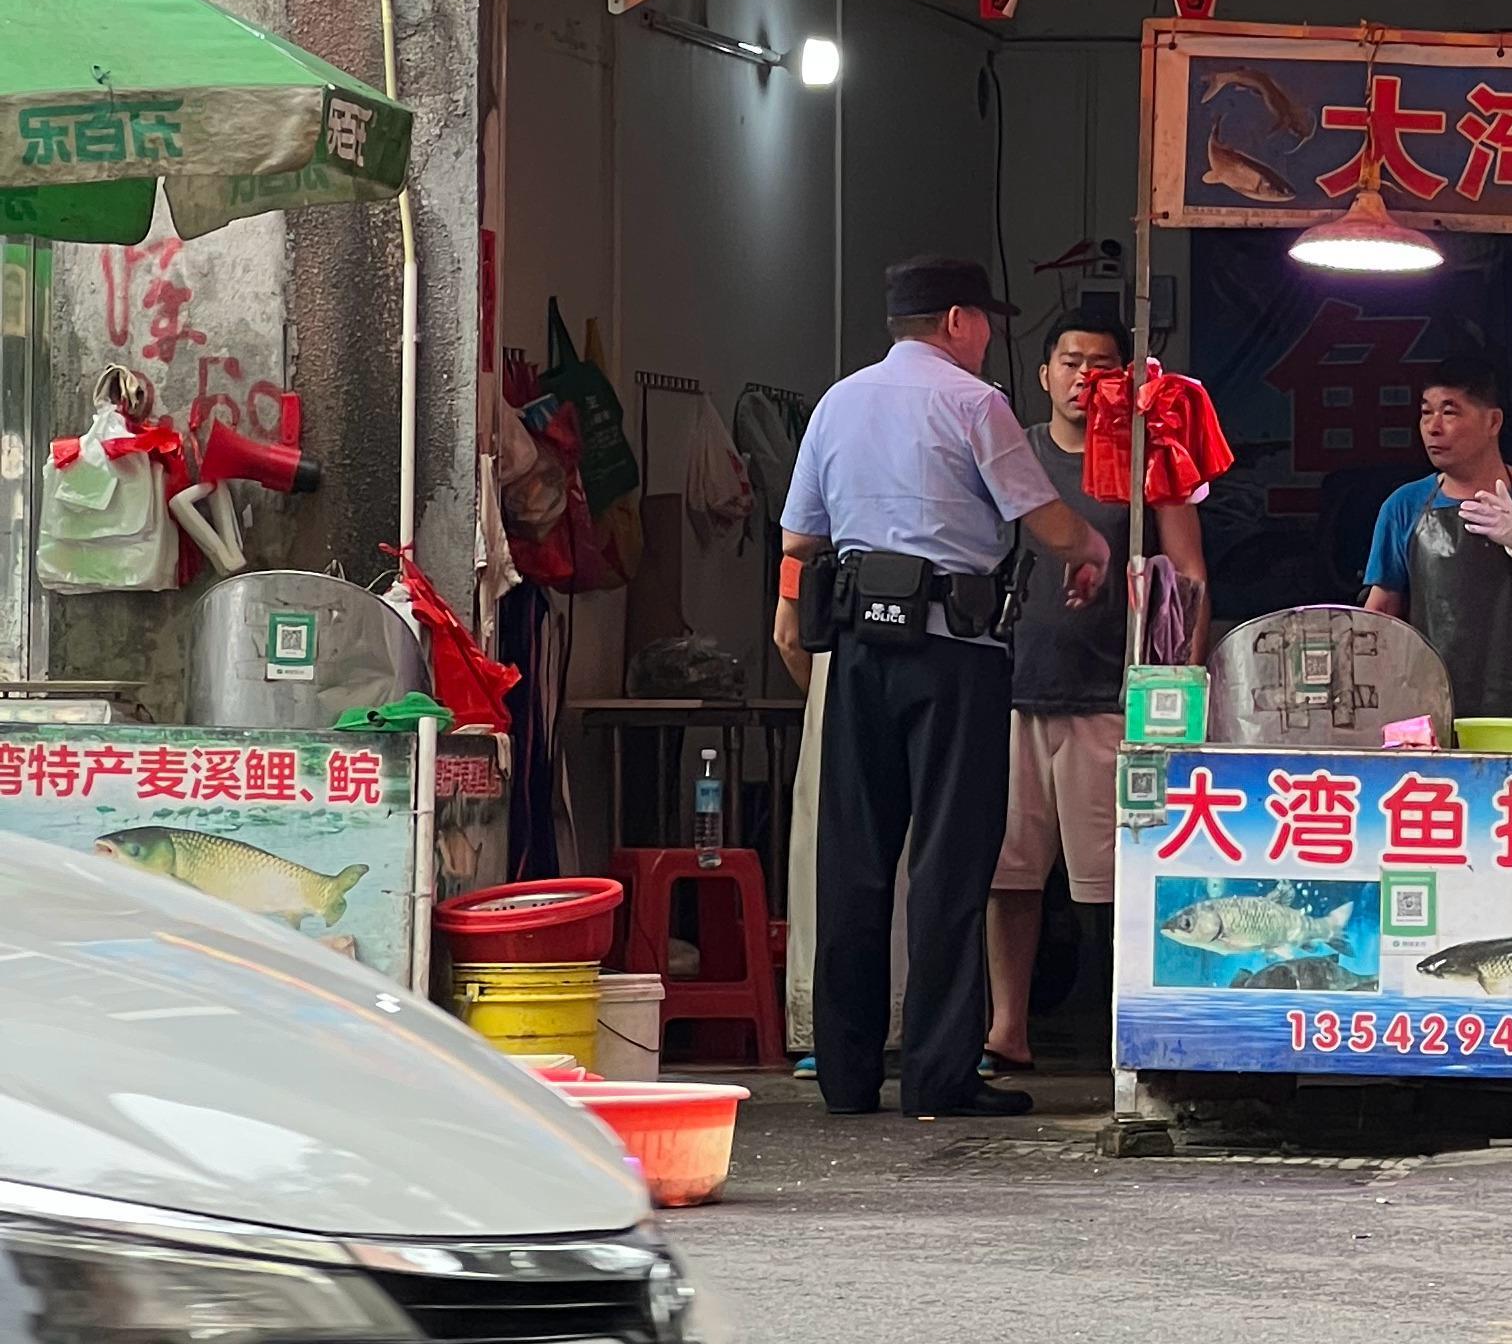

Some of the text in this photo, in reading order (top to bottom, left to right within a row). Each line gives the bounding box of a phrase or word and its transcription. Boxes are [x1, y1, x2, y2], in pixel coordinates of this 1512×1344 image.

[19, 98, 184, 166] 乐百氏
[864, 610, 906, 624] POLICE
